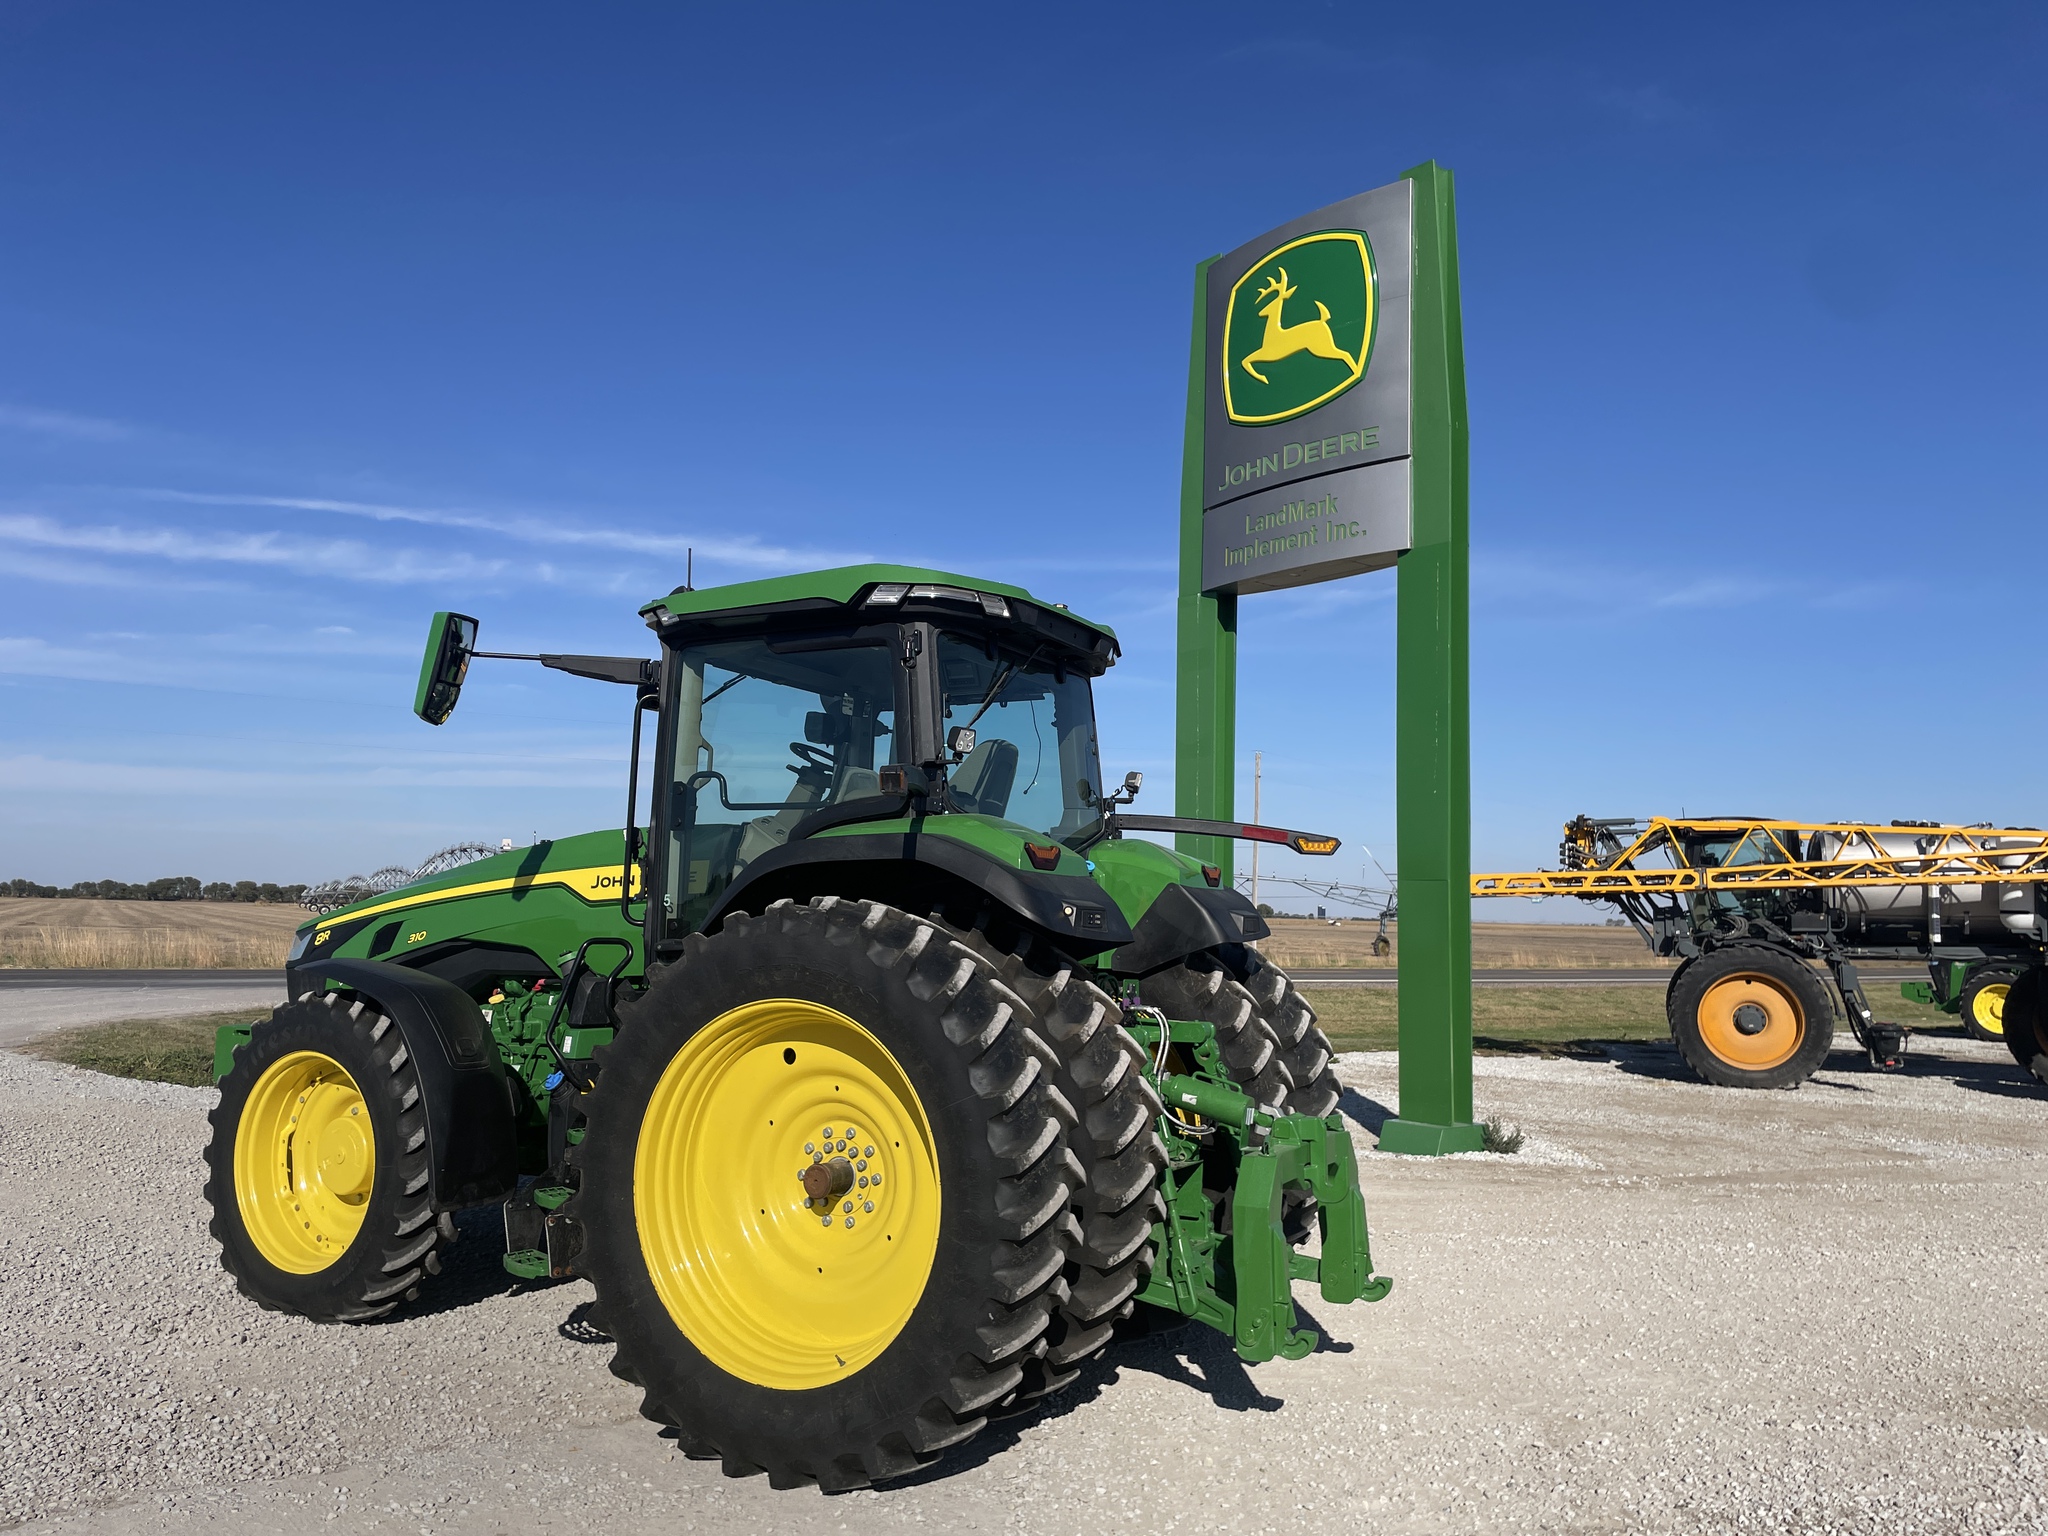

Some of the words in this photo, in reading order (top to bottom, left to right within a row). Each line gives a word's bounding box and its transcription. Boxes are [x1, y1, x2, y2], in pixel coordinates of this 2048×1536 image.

[1218, 452, 1279, 491] JOHN
[1283, 426, 1380, 470] DEERE
[1245, 493, 1339, 535] LandMark
[1224, 524, 1318, 567] Implement
[1326, 520, 1367, 543] Inc.
[314, 930, 331, 945] 8R
[407, 930, 427, 944] 310
